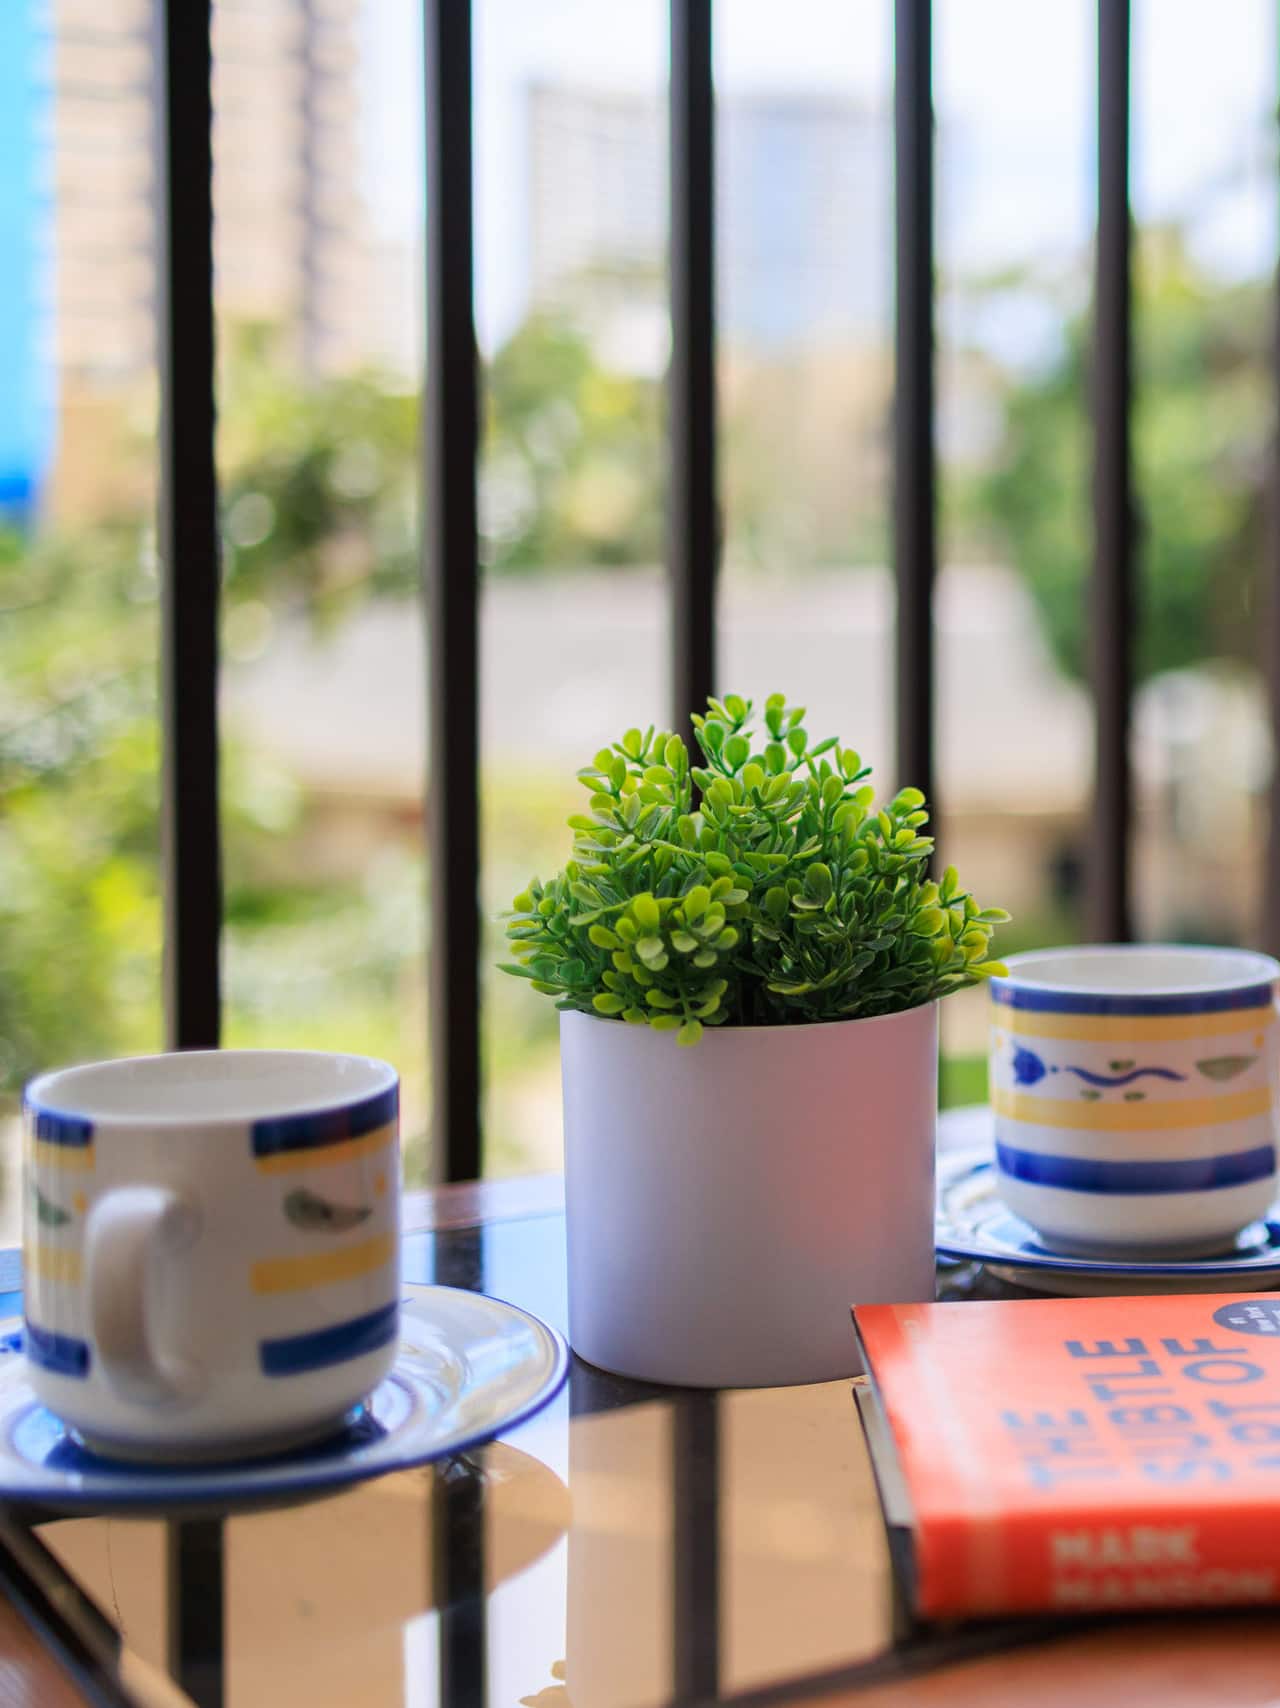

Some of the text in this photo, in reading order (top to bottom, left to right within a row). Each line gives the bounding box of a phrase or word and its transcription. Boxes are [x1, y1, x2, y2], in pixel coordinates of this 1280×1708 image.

[1161, 1337, 1266, 1385] OF
[1064, 1338, 1231, 1483] SUBTLE
[1001, 1409, 1121, 1489] THE
[1052, 1525, 1196, 1566] MARK
